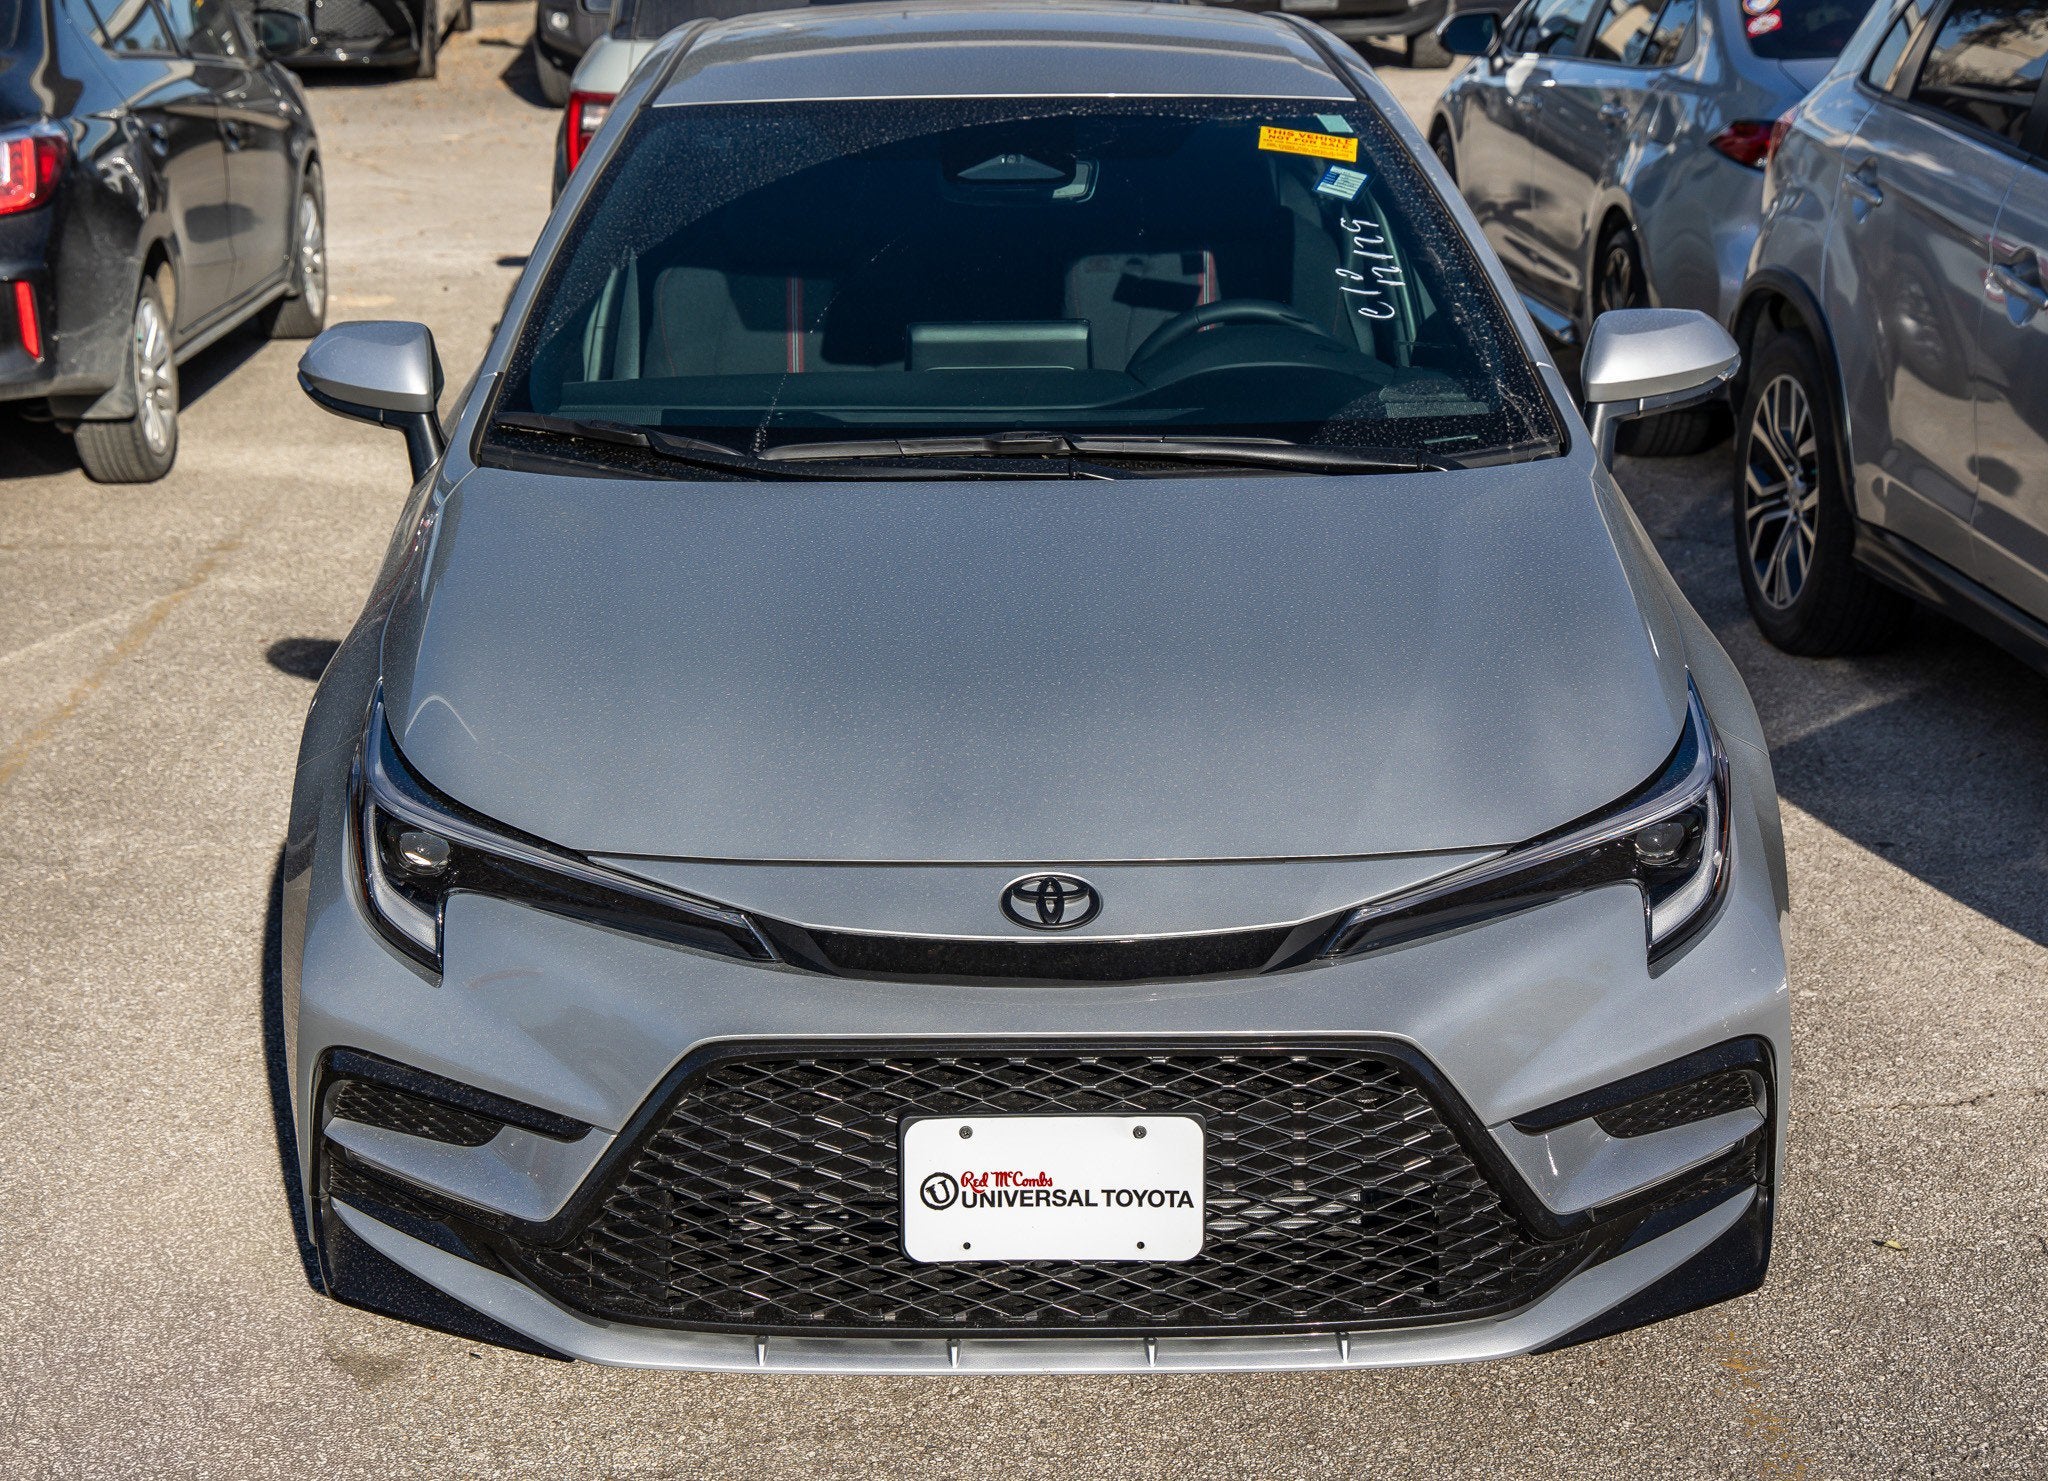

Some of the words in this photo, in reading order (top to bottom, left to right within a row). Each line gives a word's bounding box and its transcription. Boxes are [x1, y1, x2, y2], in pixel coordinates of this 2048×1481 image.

[1267, 128, 1294, 137] THIS
[1299, 132, 1352, 145] VEHICLE
[1321, 141, 1349, 149] SALE
[961, 1171, 989, 1194] Red
[991, 1171, 1053, 1188] McCombs
[961, 1189, 1098, 1209] UNIVERSAL
[1101, 1189, 1194, 1208] TOYOTA
